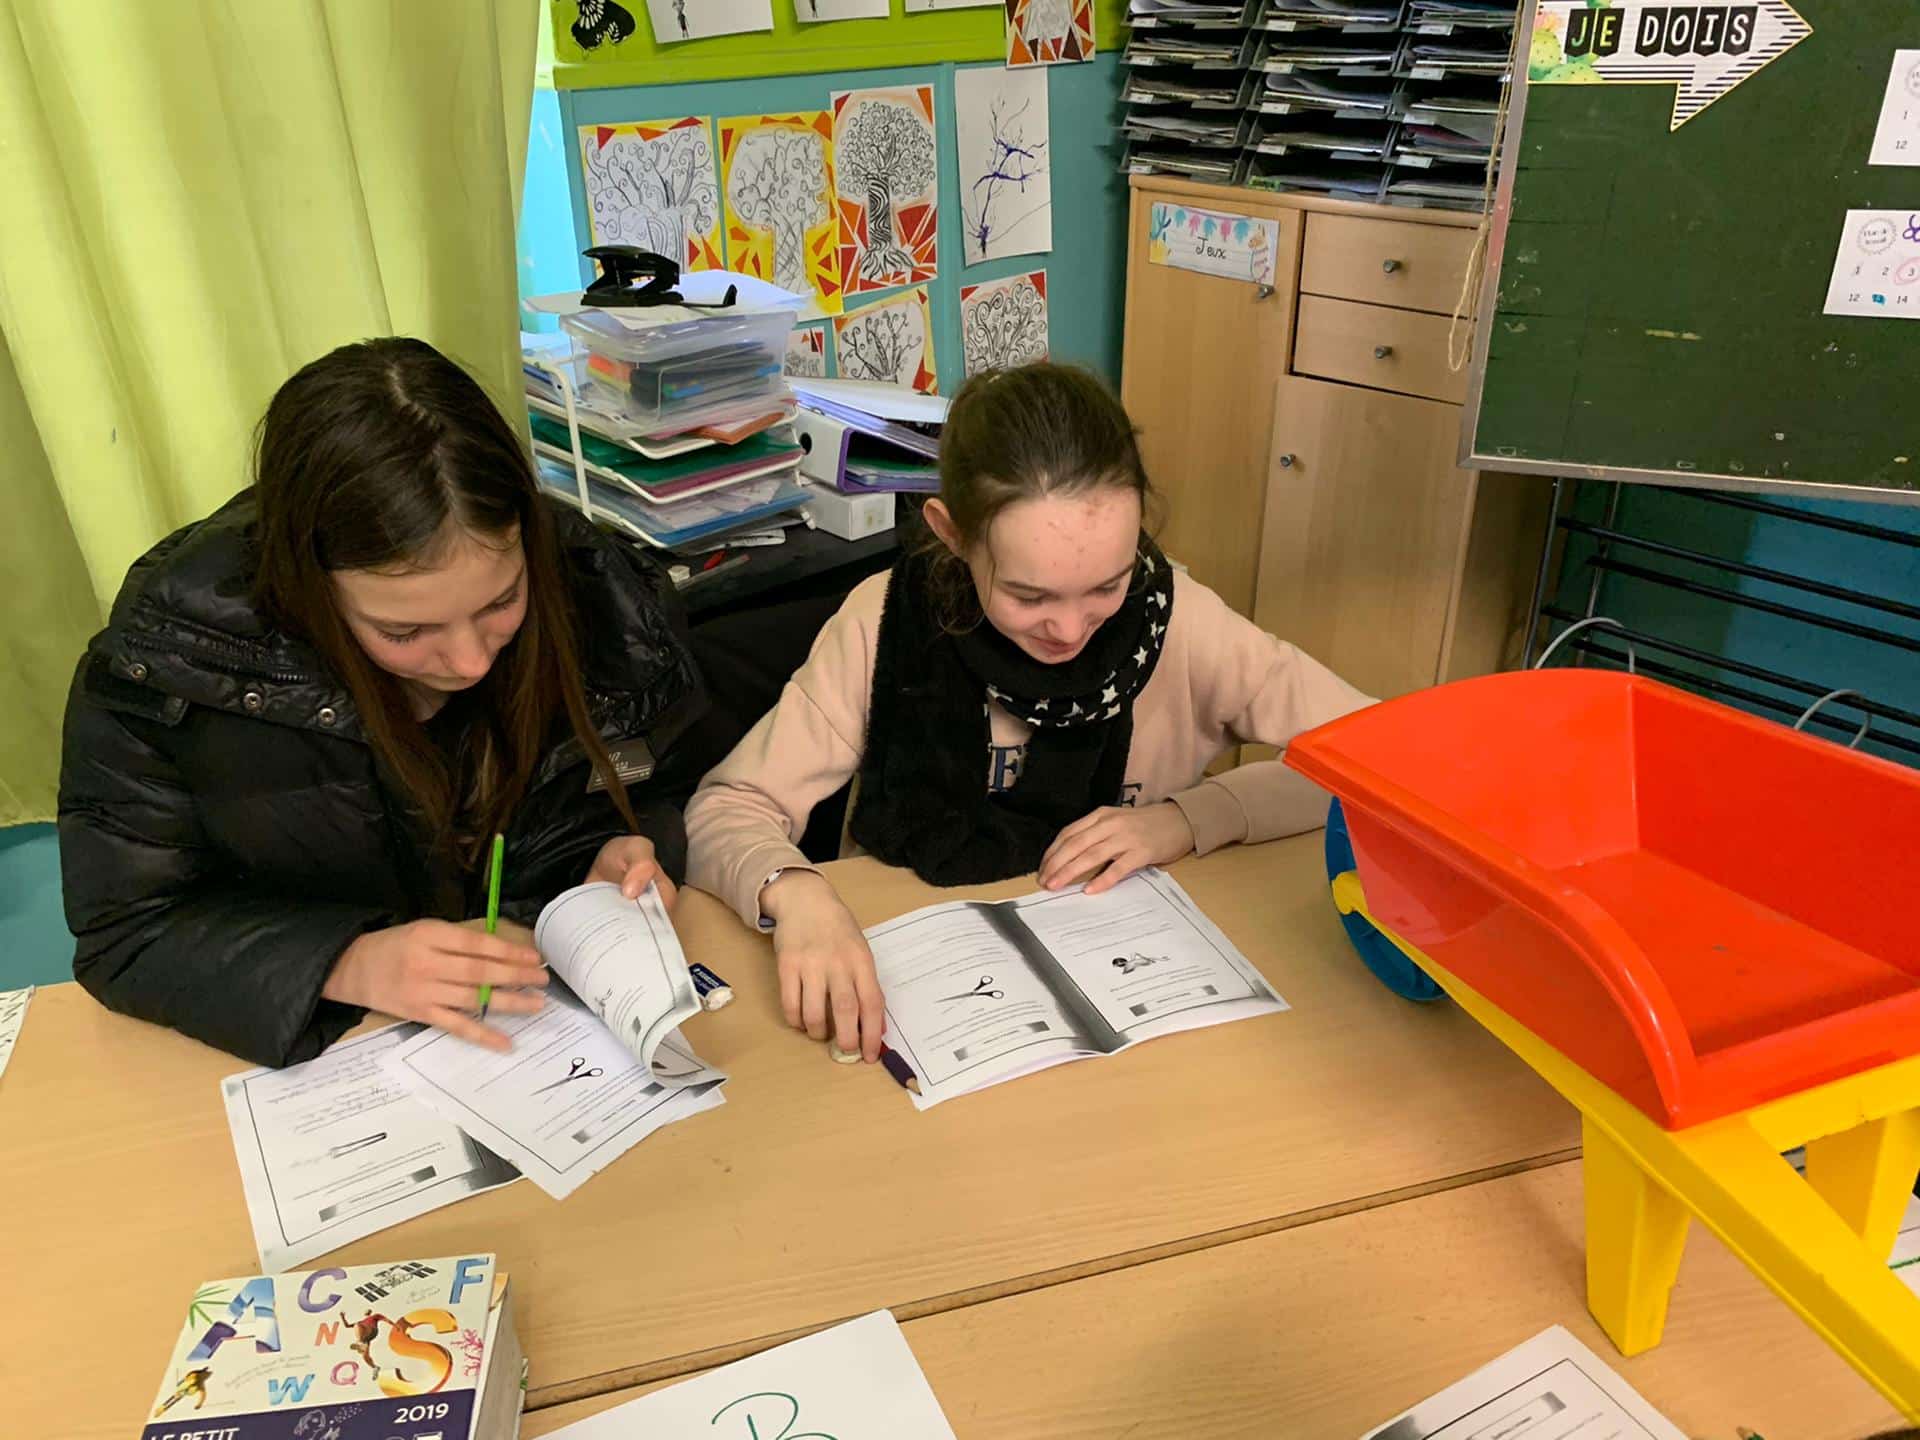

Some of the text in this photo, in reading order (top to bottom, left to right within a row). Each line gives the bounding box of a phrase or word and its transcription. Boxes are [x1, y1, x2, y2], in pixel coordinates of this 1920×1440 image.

[1570, 13, 1750, 48] JE DOIS
[1896, 140, 1908, 150] 12
[1195, 236, 1227, 259] Jeux
[298, 1267, 348, 1314] C
[448, 1256, 490, 1305] F
[314, 1321, 339, 1347] N
[329, 1361, 360, 1386] Q
[268, 1374, 314, 1405] W
[394, 1403, 449, 1424] 2019
